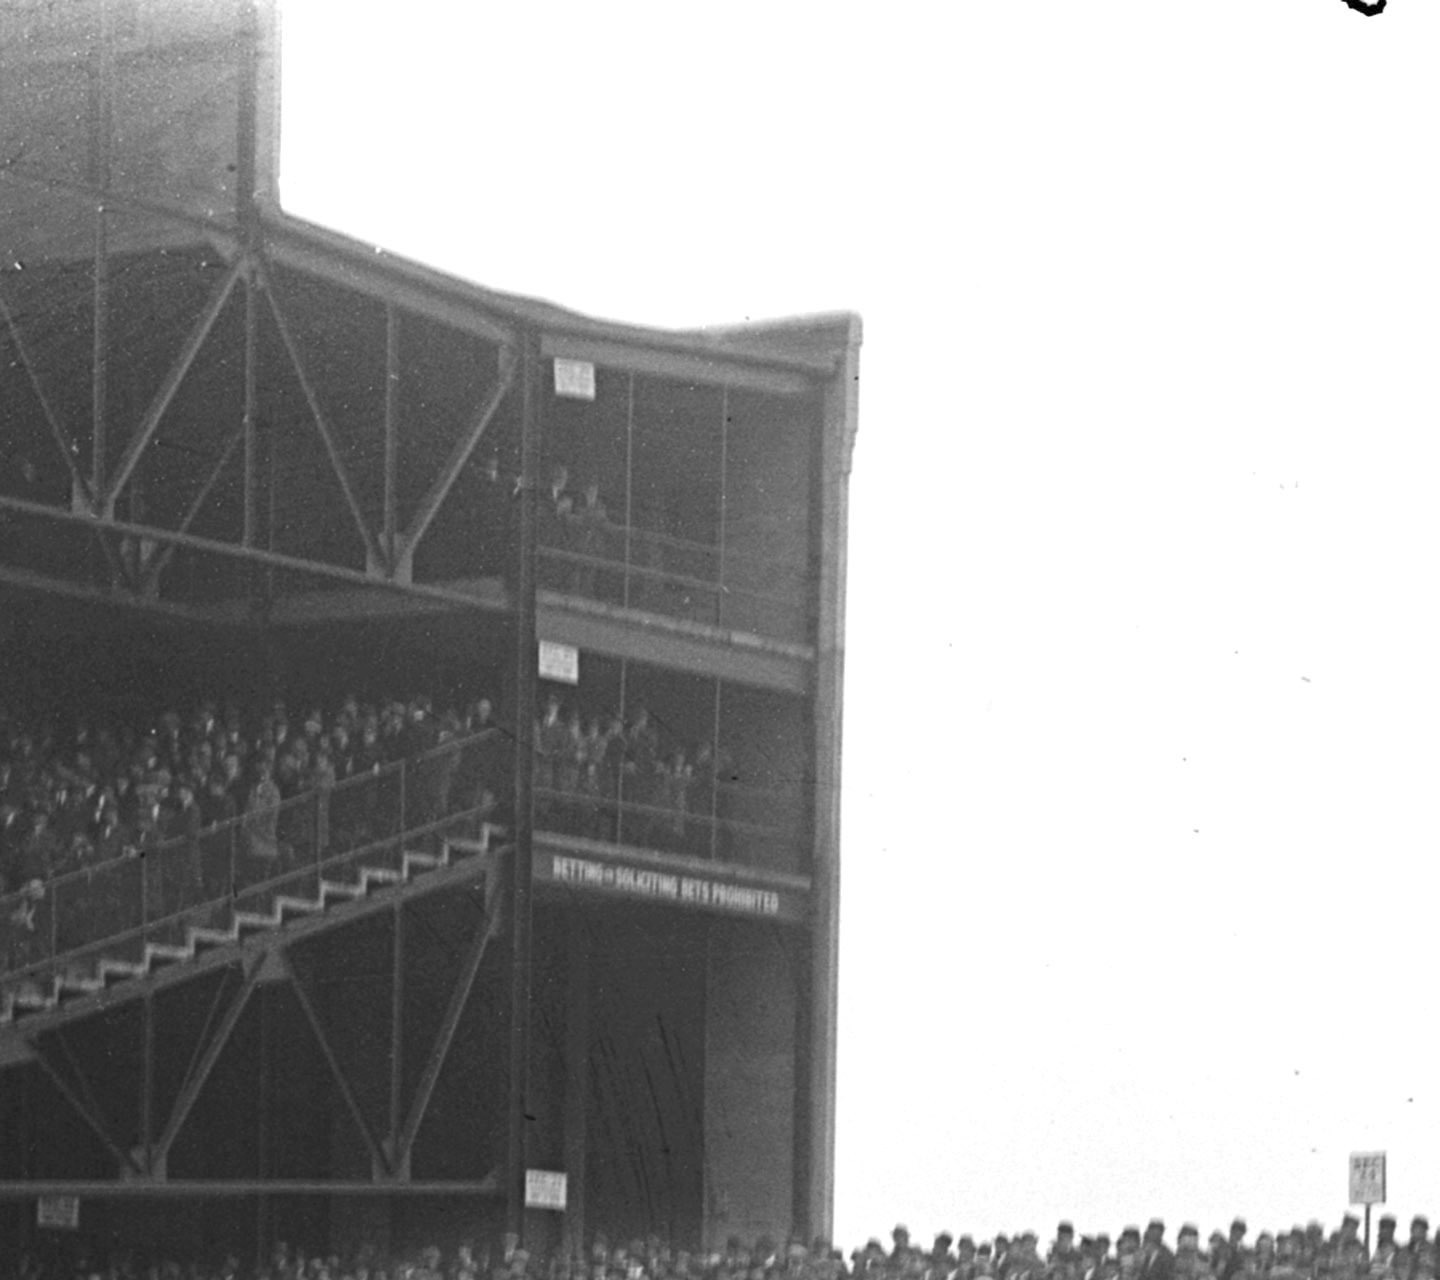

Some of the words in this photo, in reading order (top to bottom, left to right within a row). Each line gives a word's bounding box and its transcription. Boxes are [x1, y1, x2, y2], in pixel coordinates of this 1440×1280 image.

[553, 856, 603, 888] BETTING
[616, 866, 678, 899] SOLICITING
[681, 876, 710, 902] BETS
[712, 882, 779, 914] PROHIBITED
